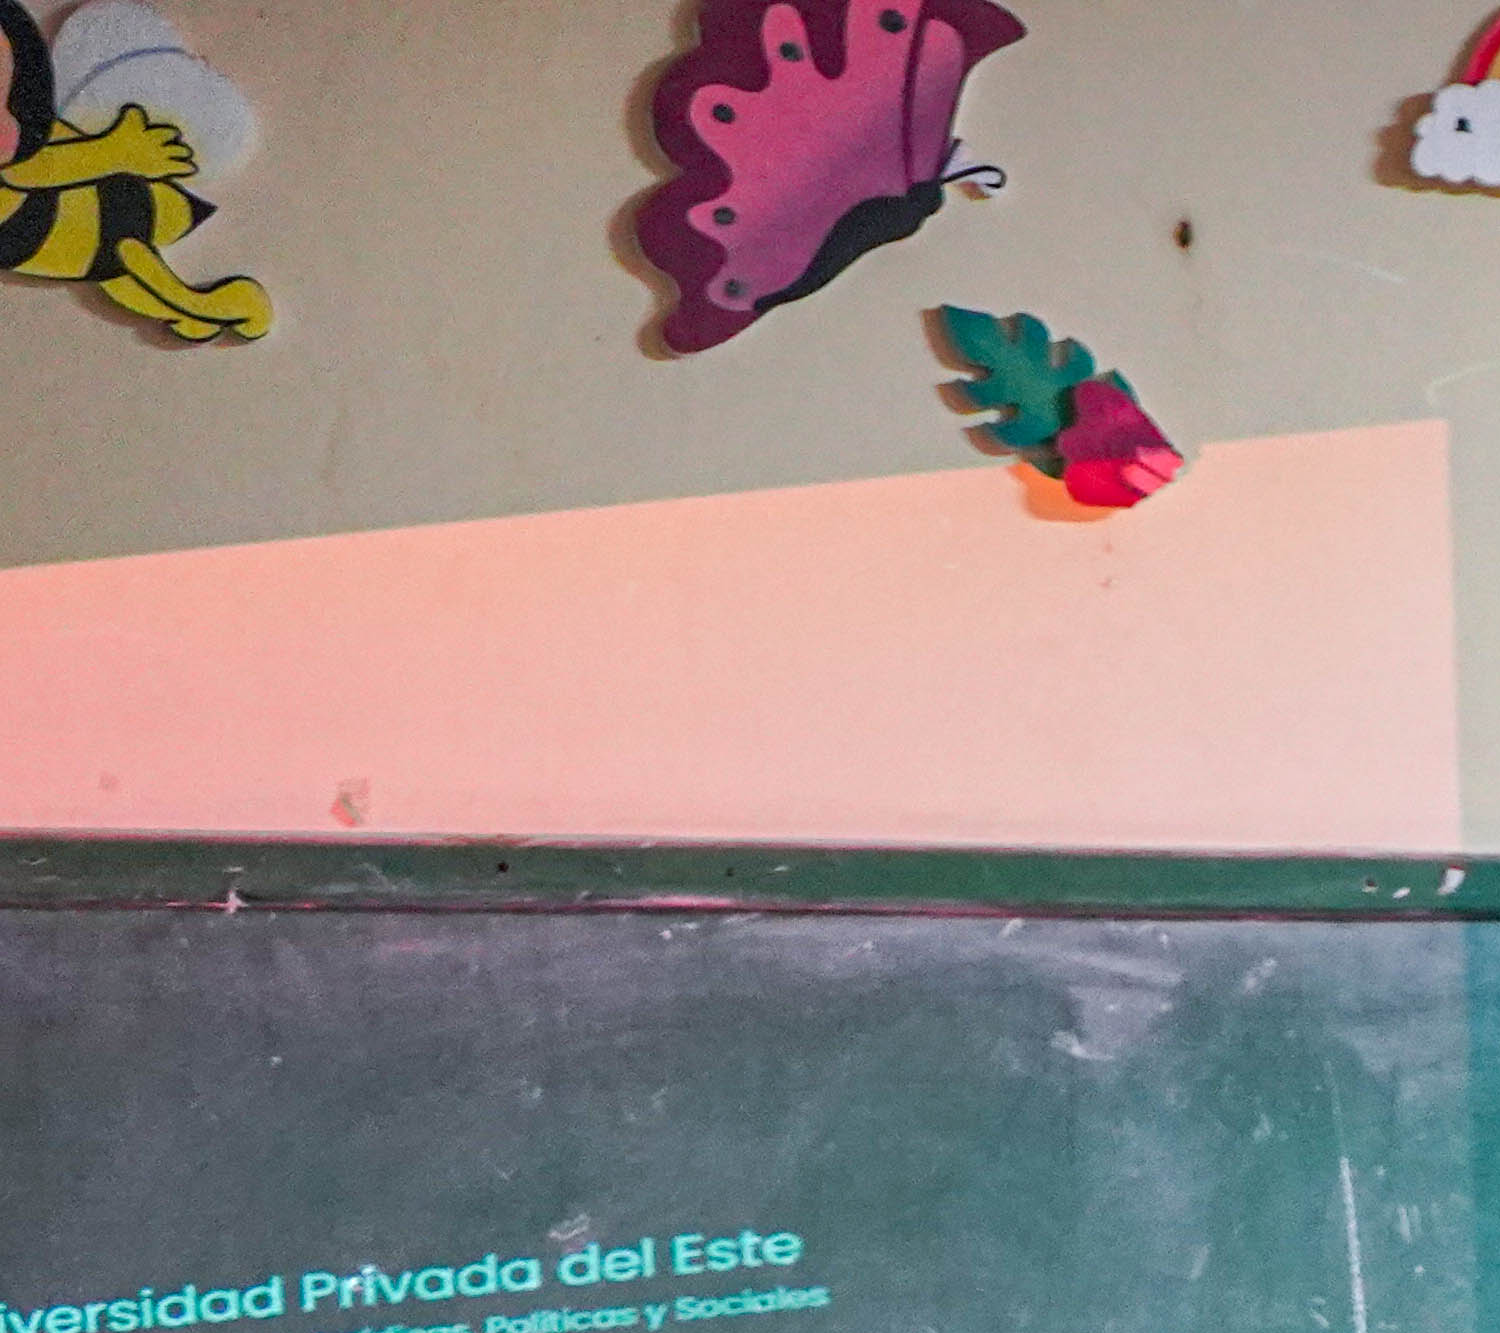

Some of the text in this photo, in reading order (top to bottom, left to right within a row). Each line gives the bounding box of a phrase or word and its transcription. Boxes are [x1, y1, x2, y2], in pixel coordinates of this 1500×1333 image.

[300, 1251, 544, 1313] Privada
[556, 1237, 657, 1286] del
[670, 1229, 805, 1277] Este
[641, 1302, 669, 1332] y
[672, 1285, 833, 1322] Sociales
